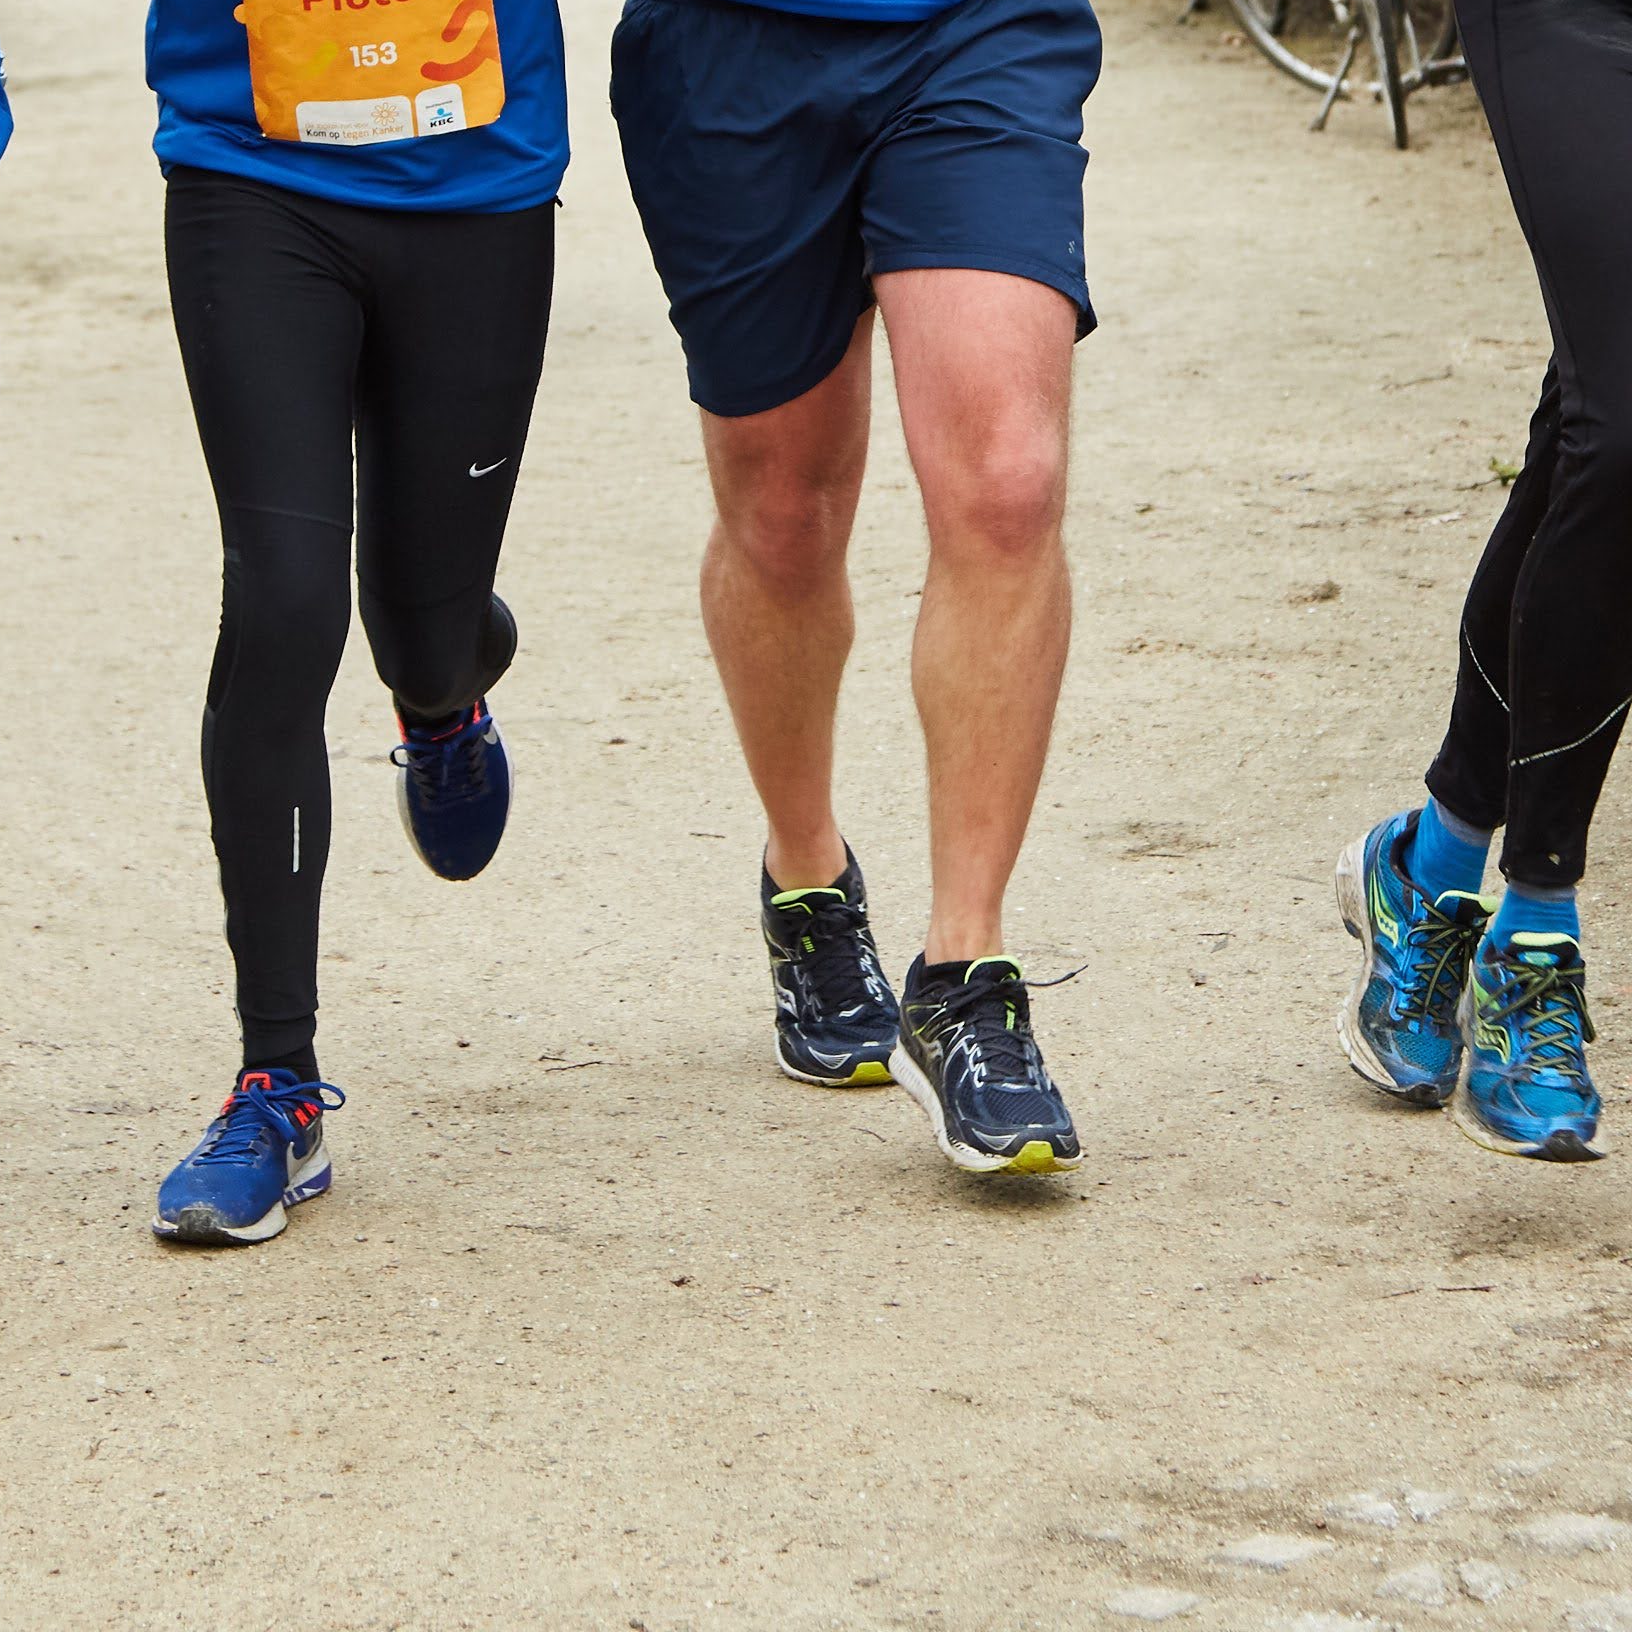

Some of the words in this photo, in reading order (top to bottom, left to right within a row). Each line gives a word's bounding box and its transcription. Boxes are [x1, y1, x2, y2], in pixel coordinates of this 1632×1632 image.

[349, 41, 398, 68] 153
[306, 128, 327, 138] Kom
[329, 129, 340, 140] op
